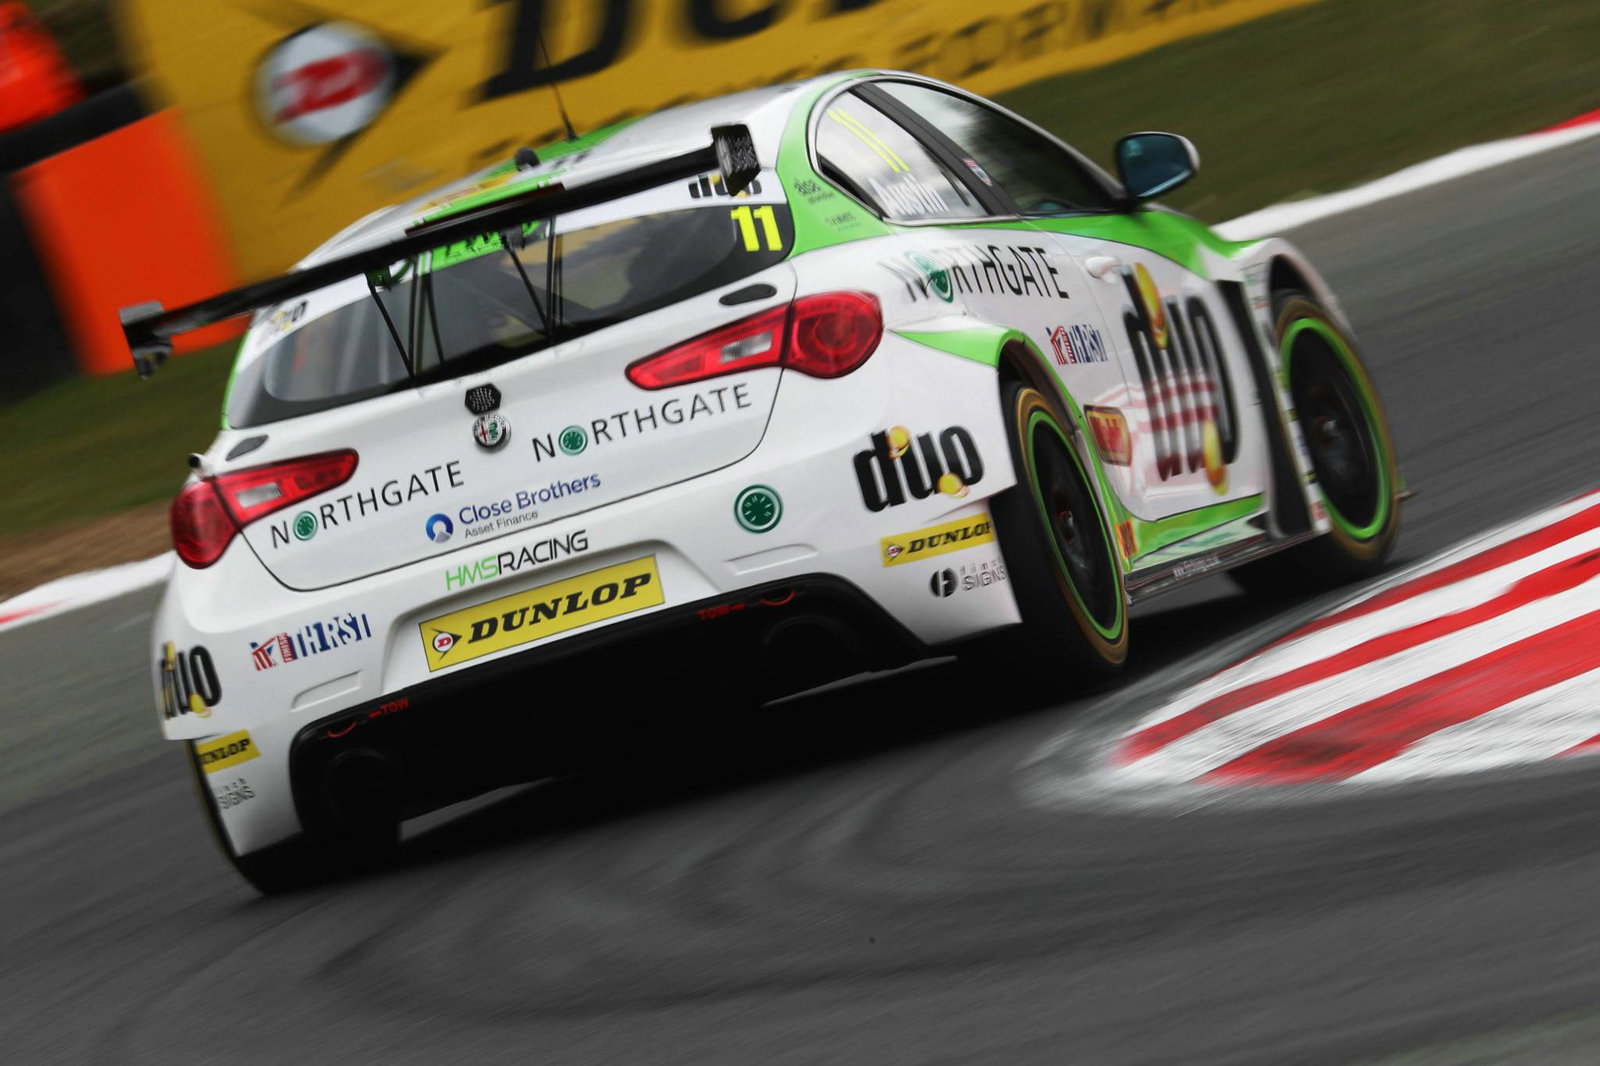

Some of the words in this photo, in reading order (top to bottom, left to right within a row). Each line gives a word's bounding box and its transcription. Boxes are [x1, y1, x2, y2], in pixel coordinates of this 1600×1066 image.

[731, 205, 783, 252] 11
[1120, 263, 1240, 492] duo
[531, 383, 752, 462] NORTHGATE
[270, 460, 464, 549] NORTHGATE
[459, 496, 512, 525] Close
[515, 473, 601, 510] Brothers
[853, 425, 985, 513] duo
[465, 522, 494, 539] Asset
[496, 510, 539, 530] Finance
[467, 572, 652, 644] DUNLOP
[160, 640, 222, 720] duo
[379, 698, 409, 715] TOW
